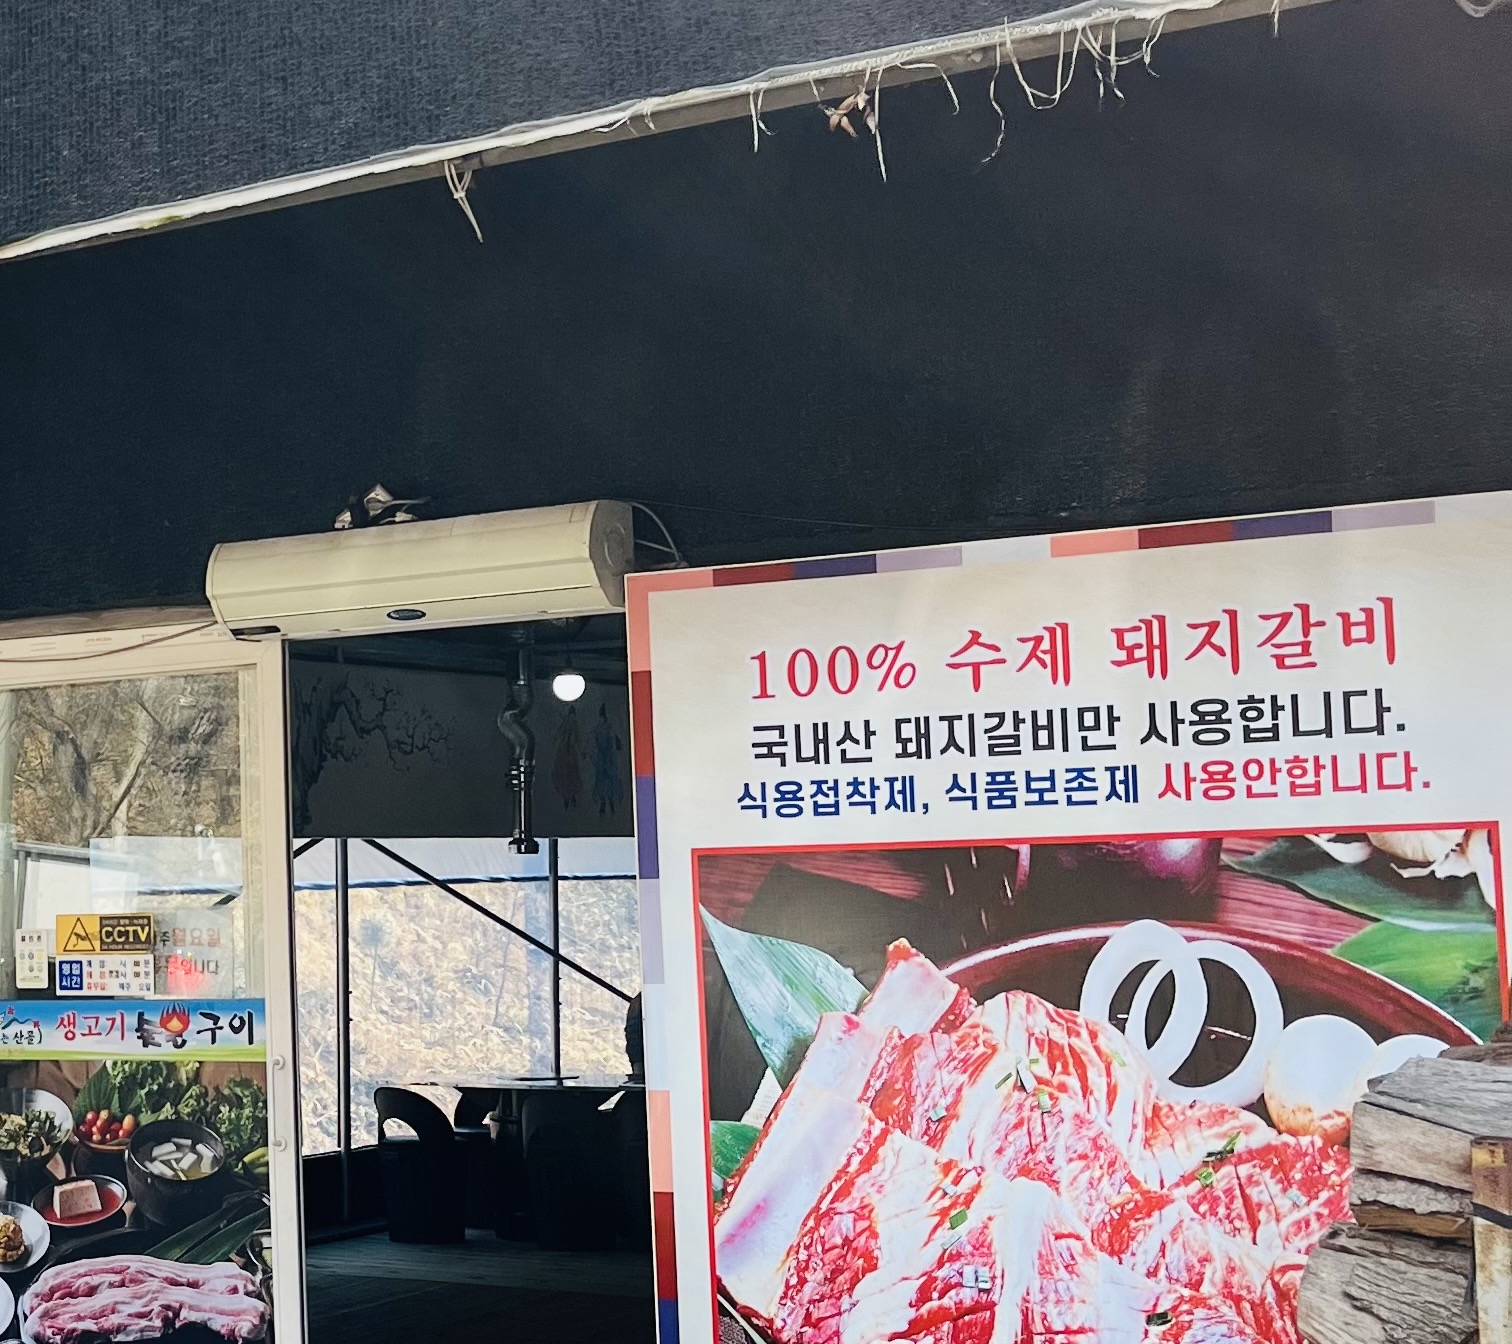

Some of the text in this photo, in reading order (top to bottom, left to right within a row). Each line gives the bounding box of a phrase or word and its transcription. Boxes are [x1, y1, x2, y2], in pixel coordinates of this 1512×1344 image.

[750, 596, 1396, 700] 100% 수제 돼지갈비
[751, 688, 1406, 768] 국내산 돼지갈비만 사용합니다.
[737, 750, 1430, 819] 식용접착제, 식품보존제 사용안합니다.
[101, 926, 149, 943] CCTV
[61, 962, 81, 975] 영업
[61, 975, 81, 988] 시간
[55, 1011, 125, 1042] 생고기
